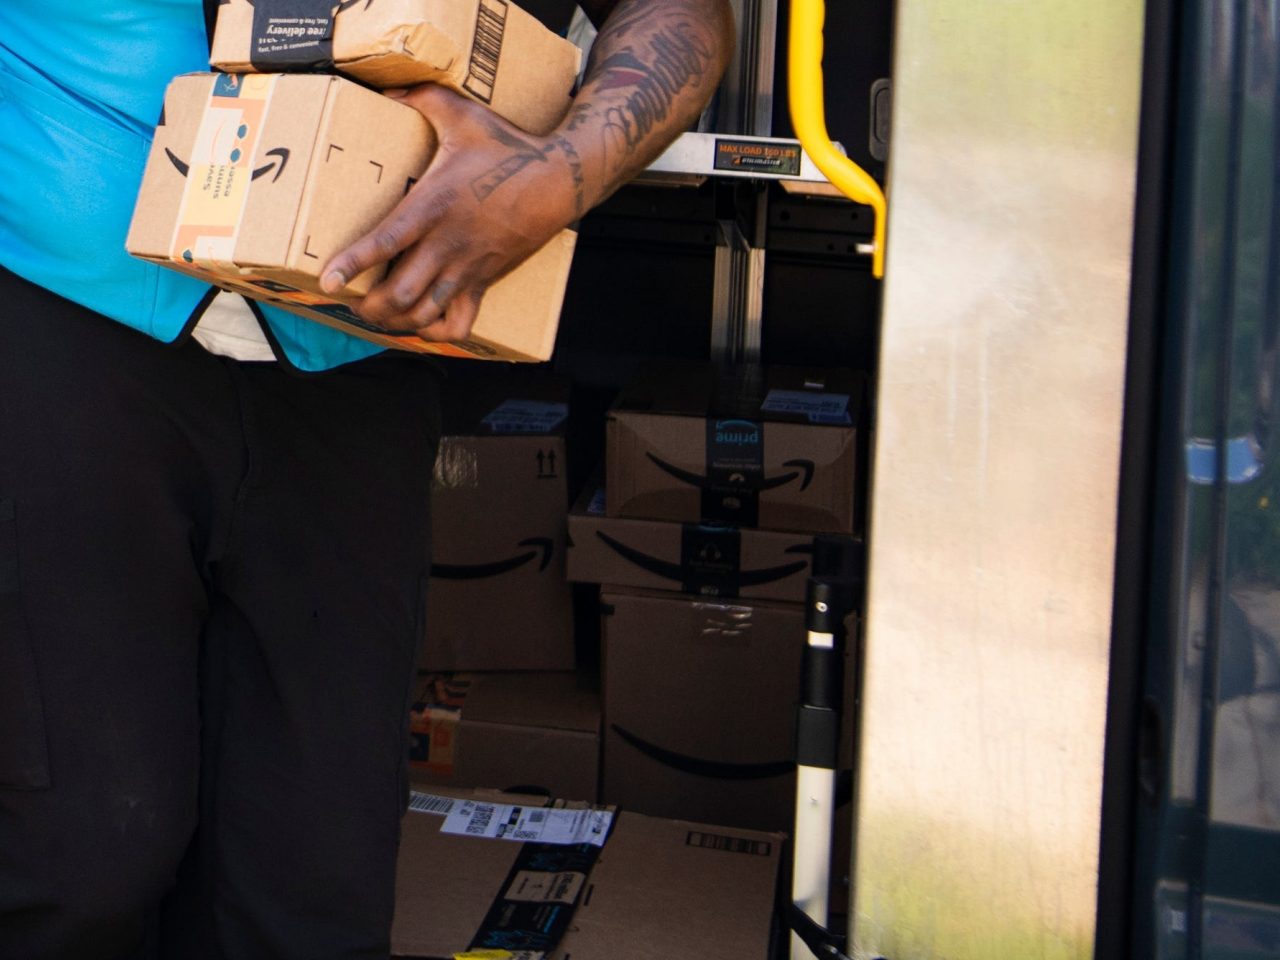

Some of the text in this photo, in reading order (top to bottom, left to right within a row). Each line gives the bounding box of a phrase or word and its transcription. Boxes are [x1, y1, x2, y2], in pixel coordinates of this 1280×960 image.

[266, 24, 306, 37] delivery
[720, 144, 737, 153] MAX
[739, 145, 762, 155] LOAD
[715, 430, 759, 446] prime
